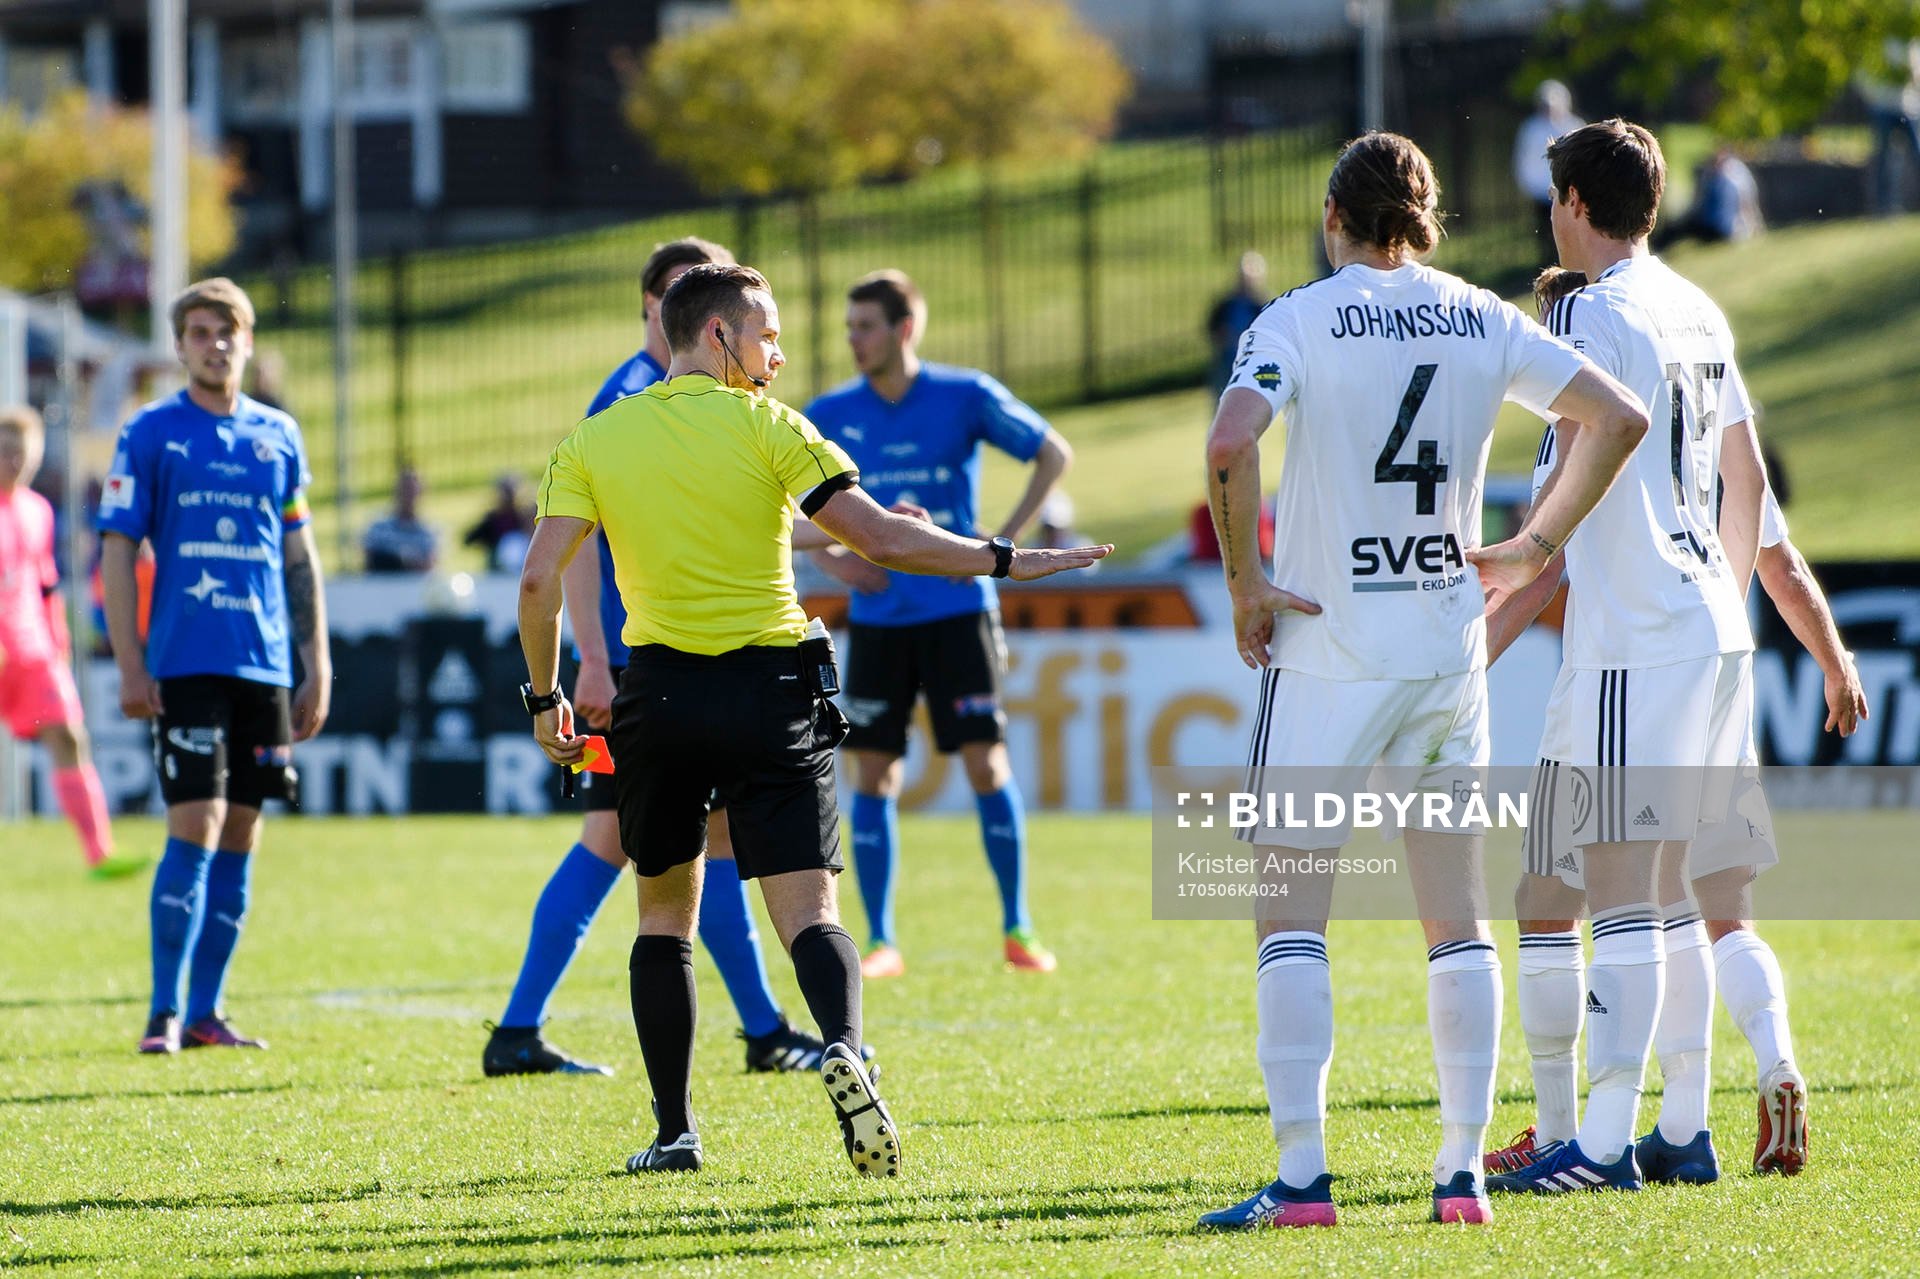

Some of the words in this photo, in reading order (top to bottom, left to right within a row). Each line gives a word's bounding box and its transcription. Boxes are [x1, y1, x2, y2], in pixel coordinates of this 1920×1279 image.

[1331, 303, 1486, 341] JOHANSSON
[1374, 363, 1448, 515] 4
[178, 489, 253, 510] GETINGE
[1351, 533, 1464, 576] SVEA
[1633, 817, 1660, 826] adidas
[1555, 860, 1579, 874] adidas
